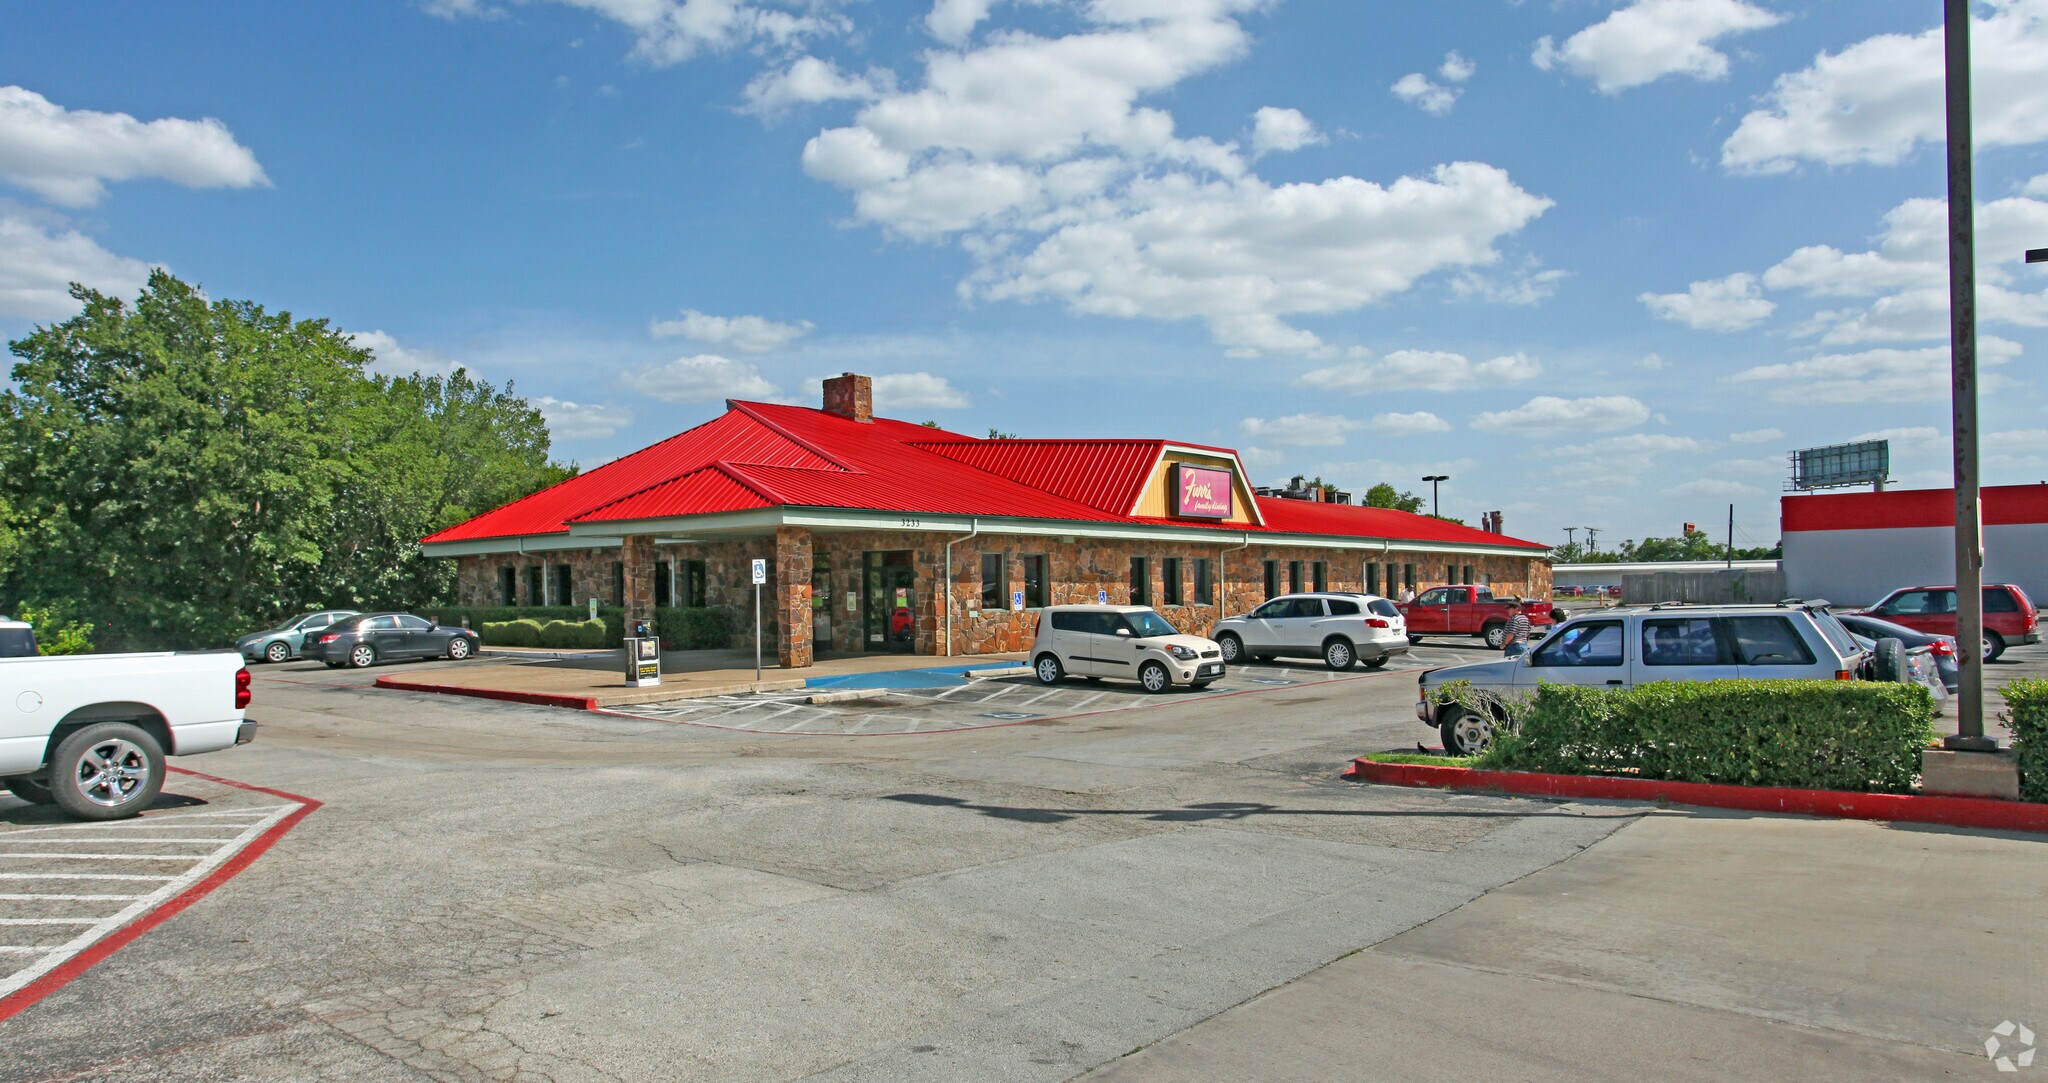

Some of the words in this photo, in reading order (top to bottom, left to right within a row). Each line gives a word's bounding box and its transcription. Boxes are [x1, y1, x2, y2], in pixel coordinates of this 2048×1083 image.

[1184, 469, 1212, 505] Furr's
[1194, 500, 1211, 512] family
[1212, 501, 1228, 514] dining
[901, 518, 920, 527] 3233
